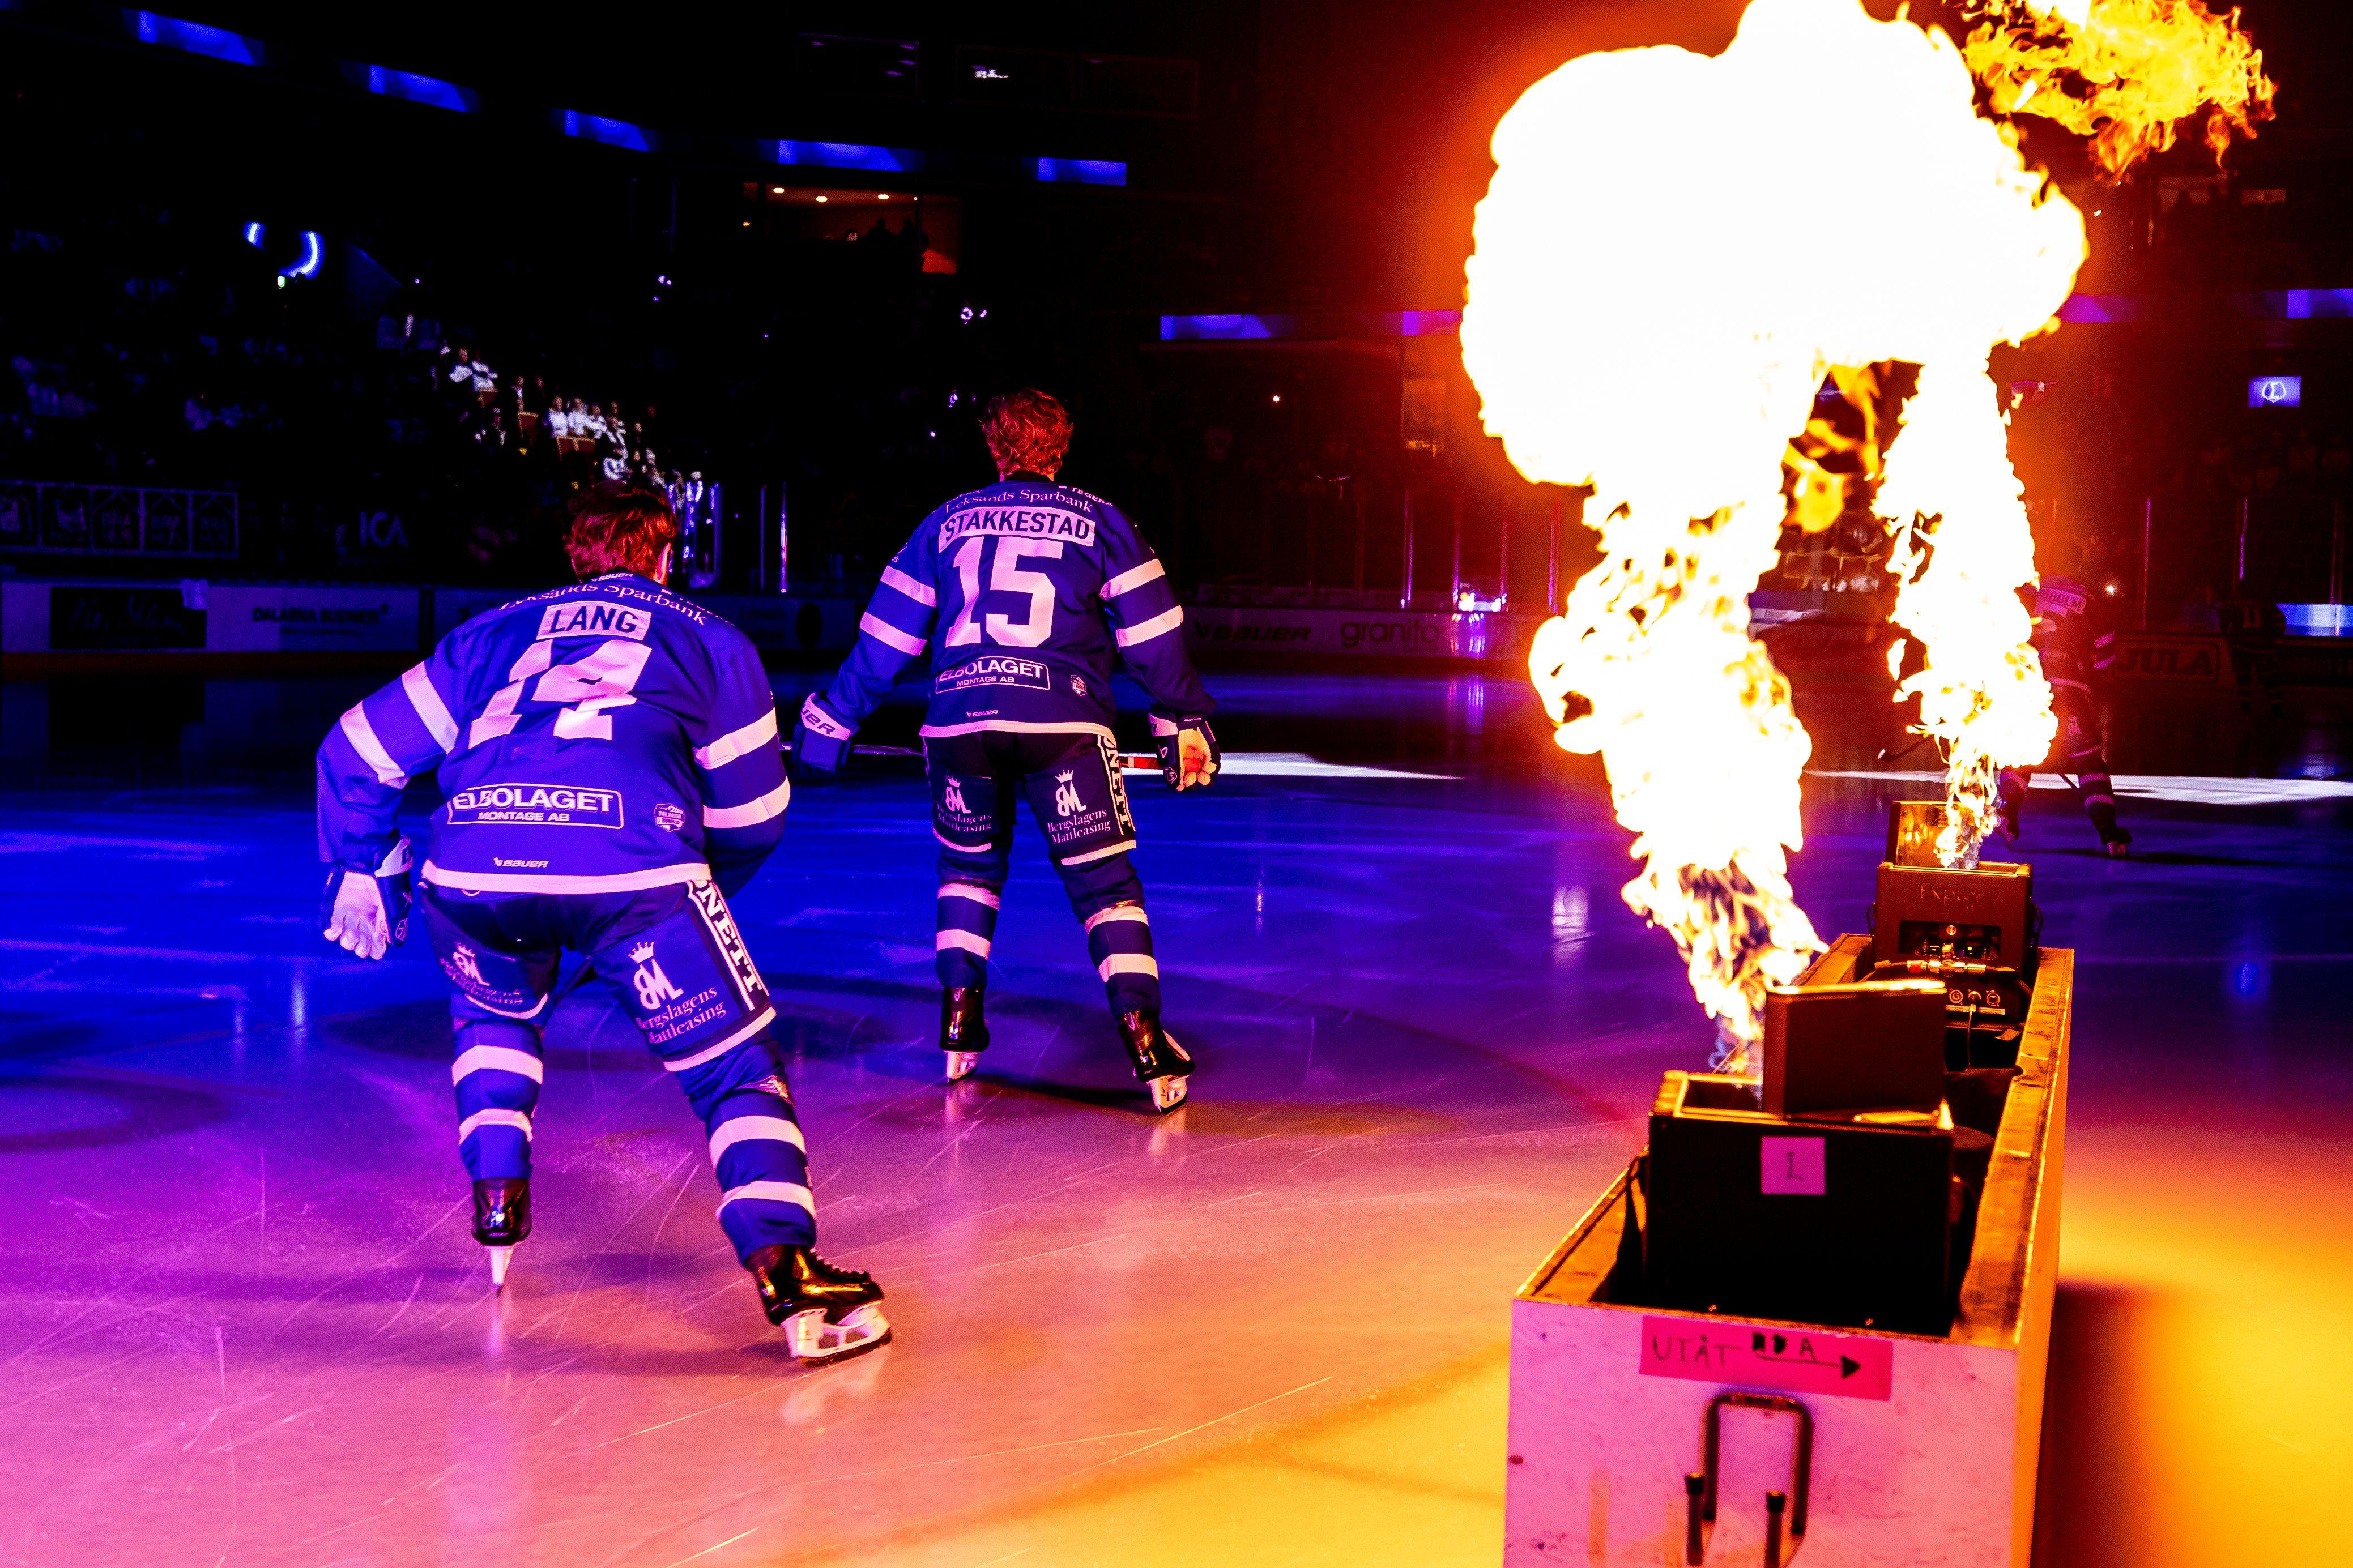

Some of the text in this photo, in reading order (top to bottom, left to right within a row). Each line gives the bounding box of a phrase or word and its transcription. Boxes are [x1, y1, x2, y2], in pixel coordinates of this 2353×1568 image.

[1020, 489, 1093, 512] Sparbank
[360, 510, 410, 548] ICA
[944, 510, 1090, 542] STAKKESTAD
[604, 584, 708, 625] Sparbank
[945, 536, 1064, 648] 15
[252, 607, 380, 625] DALARNA BUSINESS
[548, 605, 640, 634] LANG
[1210, 625, 1312, 642] BAUER
[939, 660, 1043, 682] ELBOLAGET
[956, 676, 997, 687] MONTAGE
[468, 639, 652, 750] 14
[453, 787, 615, 814] ELBOLAGET
[478, 811, 570, 822] MONTAGE AB
[1047, 808, 1107, 834] Bergslagens
[1051, 819, 1111, 845] Mattleasing
[502, 859, 549, 868] BAUER
[1784, 1151, 1804, 1181] 1
[1652, 1334, 1743, 1369] UTÅT
